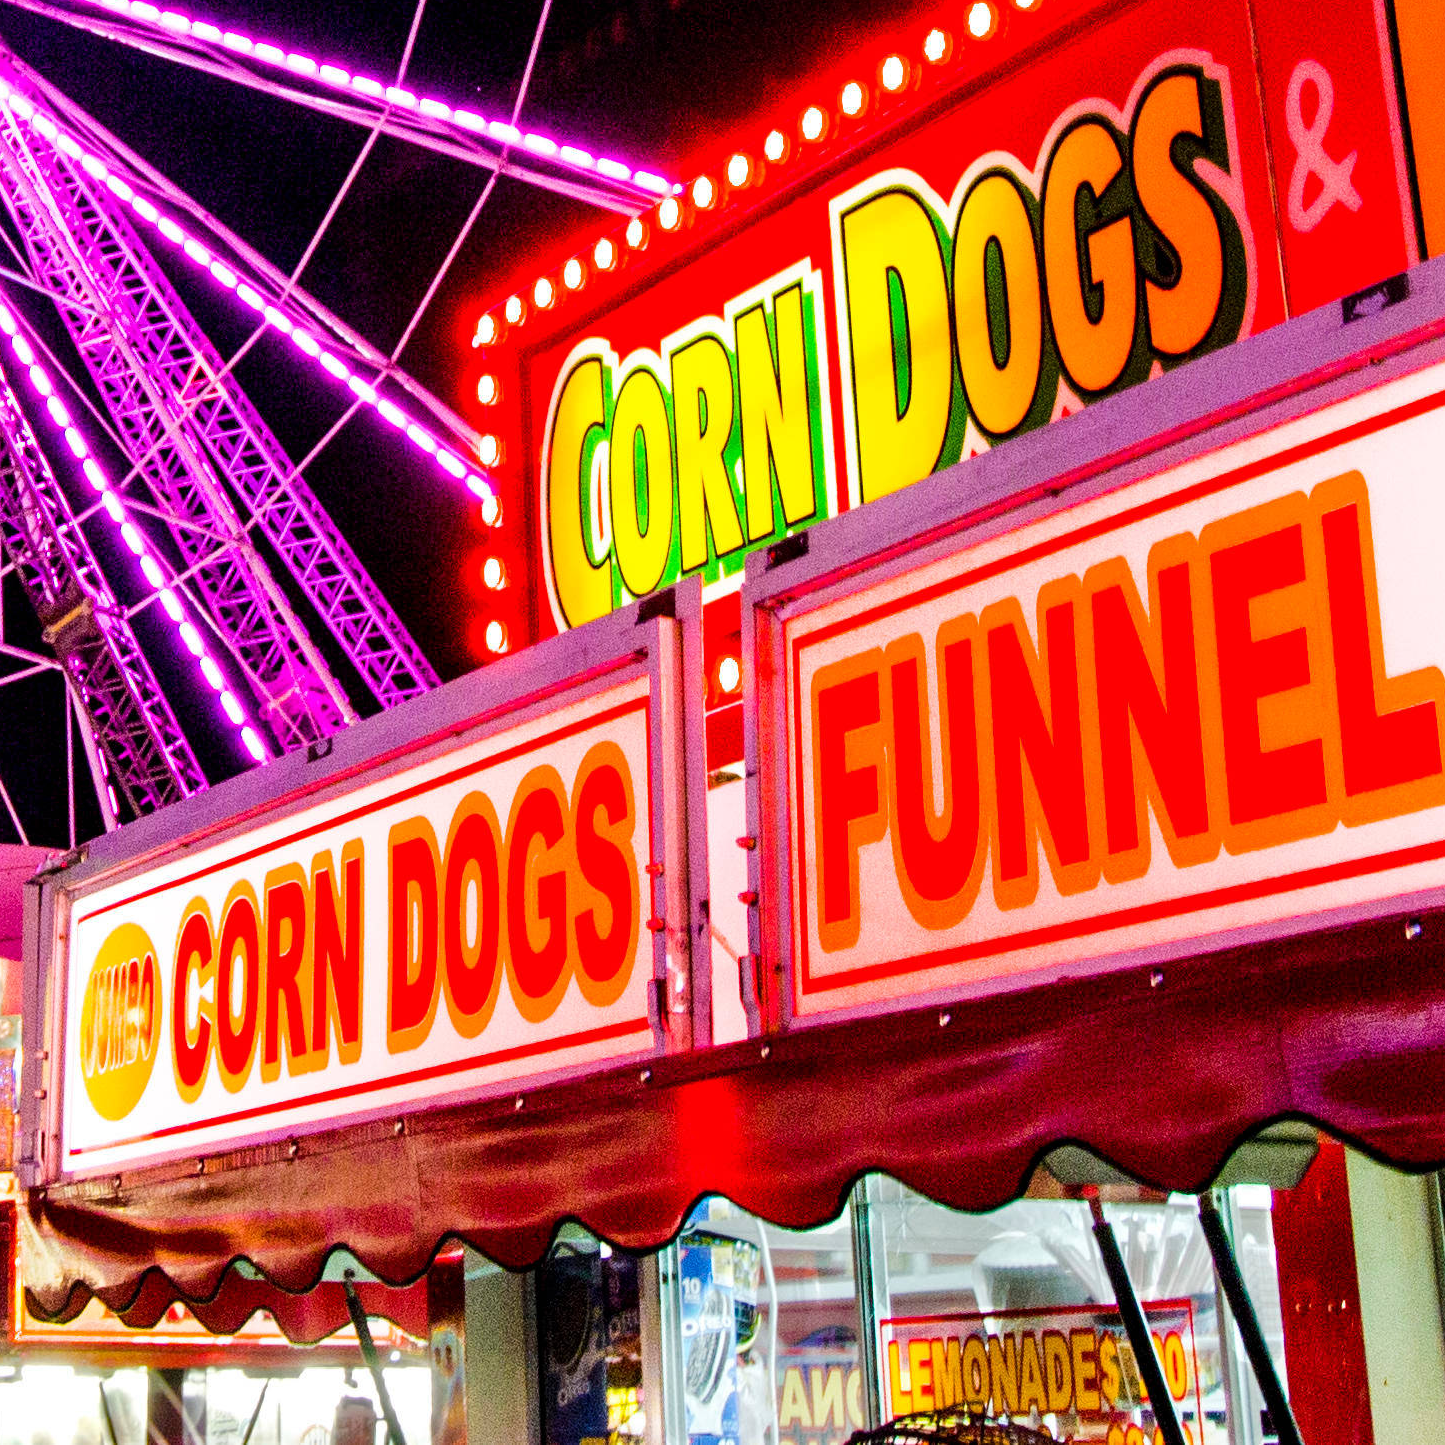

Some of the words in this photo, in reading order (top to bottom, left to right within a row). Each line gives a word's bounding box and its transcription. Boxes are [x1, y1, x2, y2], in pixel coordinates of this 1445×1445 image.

[545, 265, 833, 631] CORN
[835, 57, 1251, 505] DOGS
[1284, 59, 1362, 233] &
[84, 951, 155, 1078] JUMBO
[170, 836, 364, 1104] CORN
[387, 741, 640, 1054] DOGS
